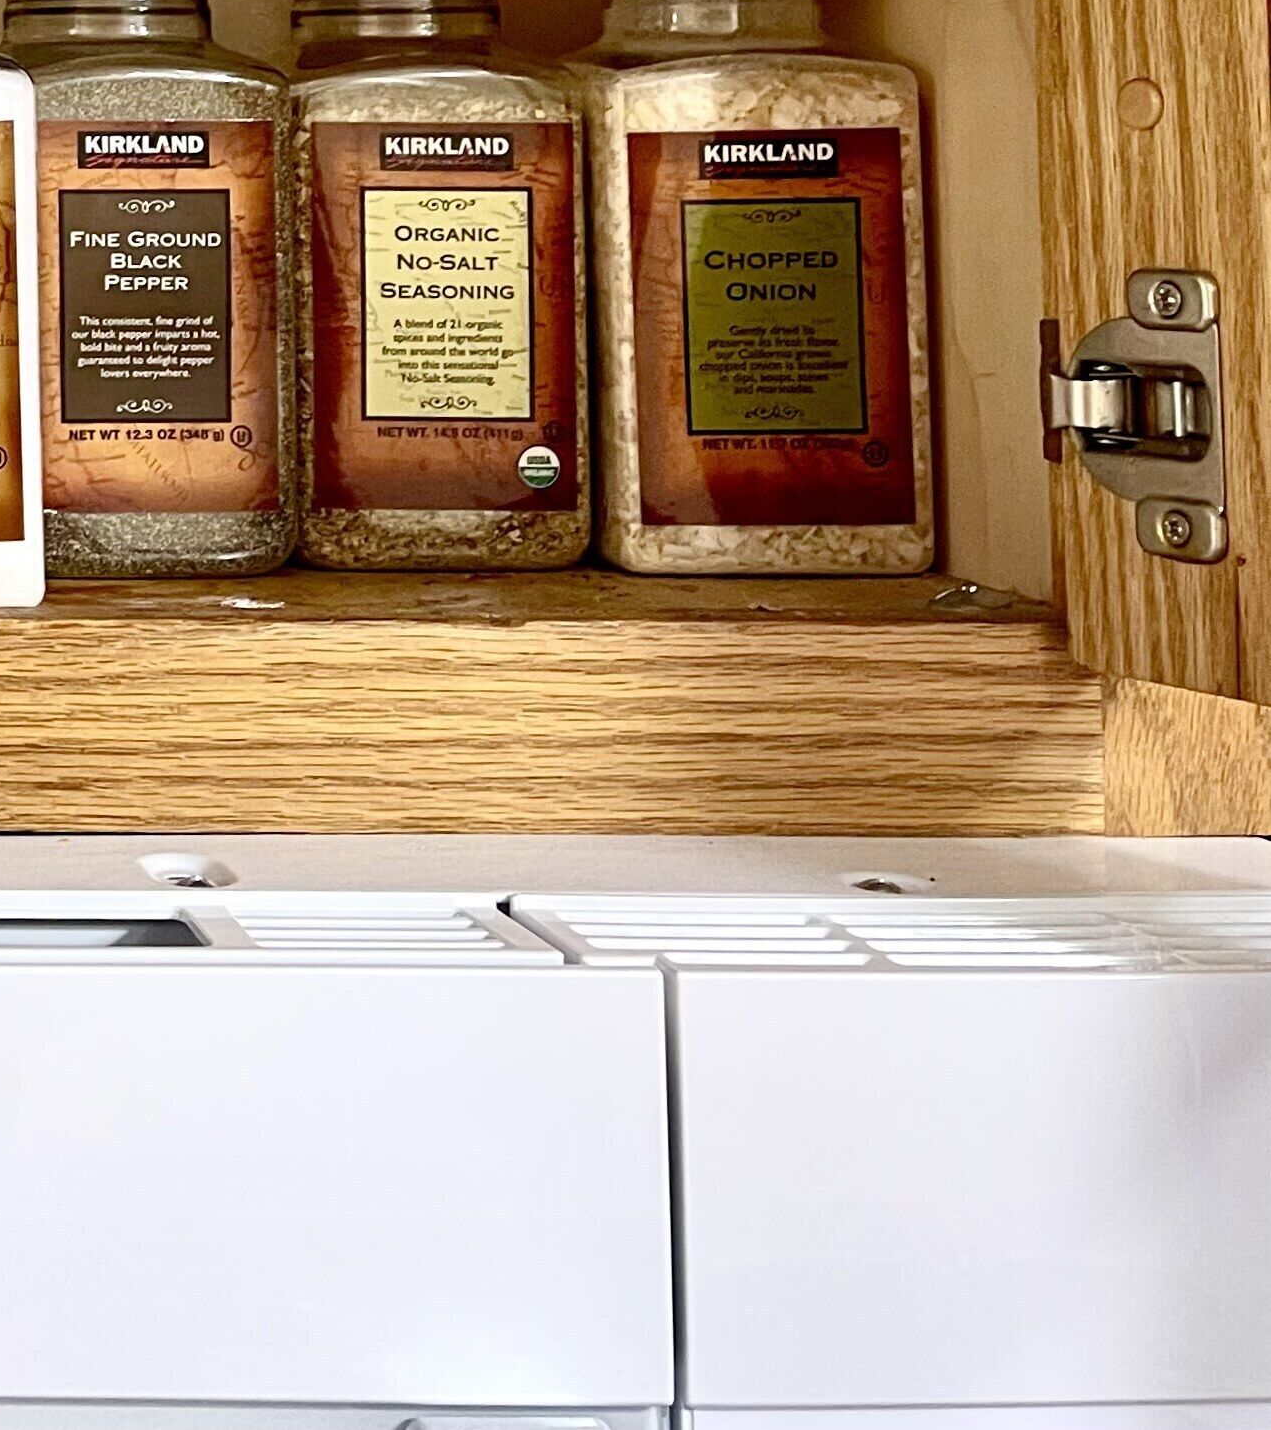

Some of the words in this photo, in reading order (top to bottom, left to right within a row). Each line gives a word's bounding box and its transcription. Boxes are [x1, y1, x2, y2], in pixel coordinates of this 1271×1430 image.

[85, 135, 205, 154] KIRKLAND
[385, 137, 510, 155] KIRKLAND
[704, 143, 834, 163] KIRKLAND
[70, 231, 120, 248] FINE
[127, 231, 222, 248] GROUND
[394, 225, 500, 242] ORGANIC
[110, 252, 182, 270] BLACK
[704, 251, 839, 270] CHOPPED
[104, 274, 189, 291] PEPPER
[380, 282, 515, 300] SEASONING
[726, 282, 817, 301] ONION
[79, 316, 99, 326] This
[155, 315, 174, 325] fine
[175, 316, 201, 328] grind
[202, 315, 214, 325] of
[394, 319, 402, 328] A
[405, 319, 433, 329] blend
[437, 319, 447, 329] of
[465, 320, 503, 331] organic
[71, 331, 89, 339] our
[91, 329, 116, 339] black
[118, 330, 153, 341] pepper
[154, 329, 191, 340] imparts
[393, 333, 423, 344] spices
[427, 333, 445, 343] and
[448, 333, 503, 345] ingredients
[80, 342, 102, 352] bold
[104, 342, 122, 352] bite
[124, 342, 143, 352] and
[153, 341, 179, 354] fruity
[180, 343, 211, 352] aroma
[382, 345, 406, 355] from
[410, 346, 446, 356] around
[449, 346, 466, 356] the
[469, 347, 498, 356] world
[501, 348, 514, 359] go
[77, 355, 131, 368] guaranteed
[132, 356, 144, 365] to
[146, 355, 178, 367] delight
[180, 356, 214, 366] pepper
[398, 360, 418, 369] into
[100, 368, 130, 378] lovers
[132, 369, 191, 380] everywhere.
[69, 429, 95, 441] NET
[100, 429, 120, 441] WT
[126, 429, 153, 441] 12.3
[158, 429, 176, 440] OZ
[377, 426, 403, 438] NET
[407, 426, 430, 438] WT.
[462, 427, 481, 438] OZ
